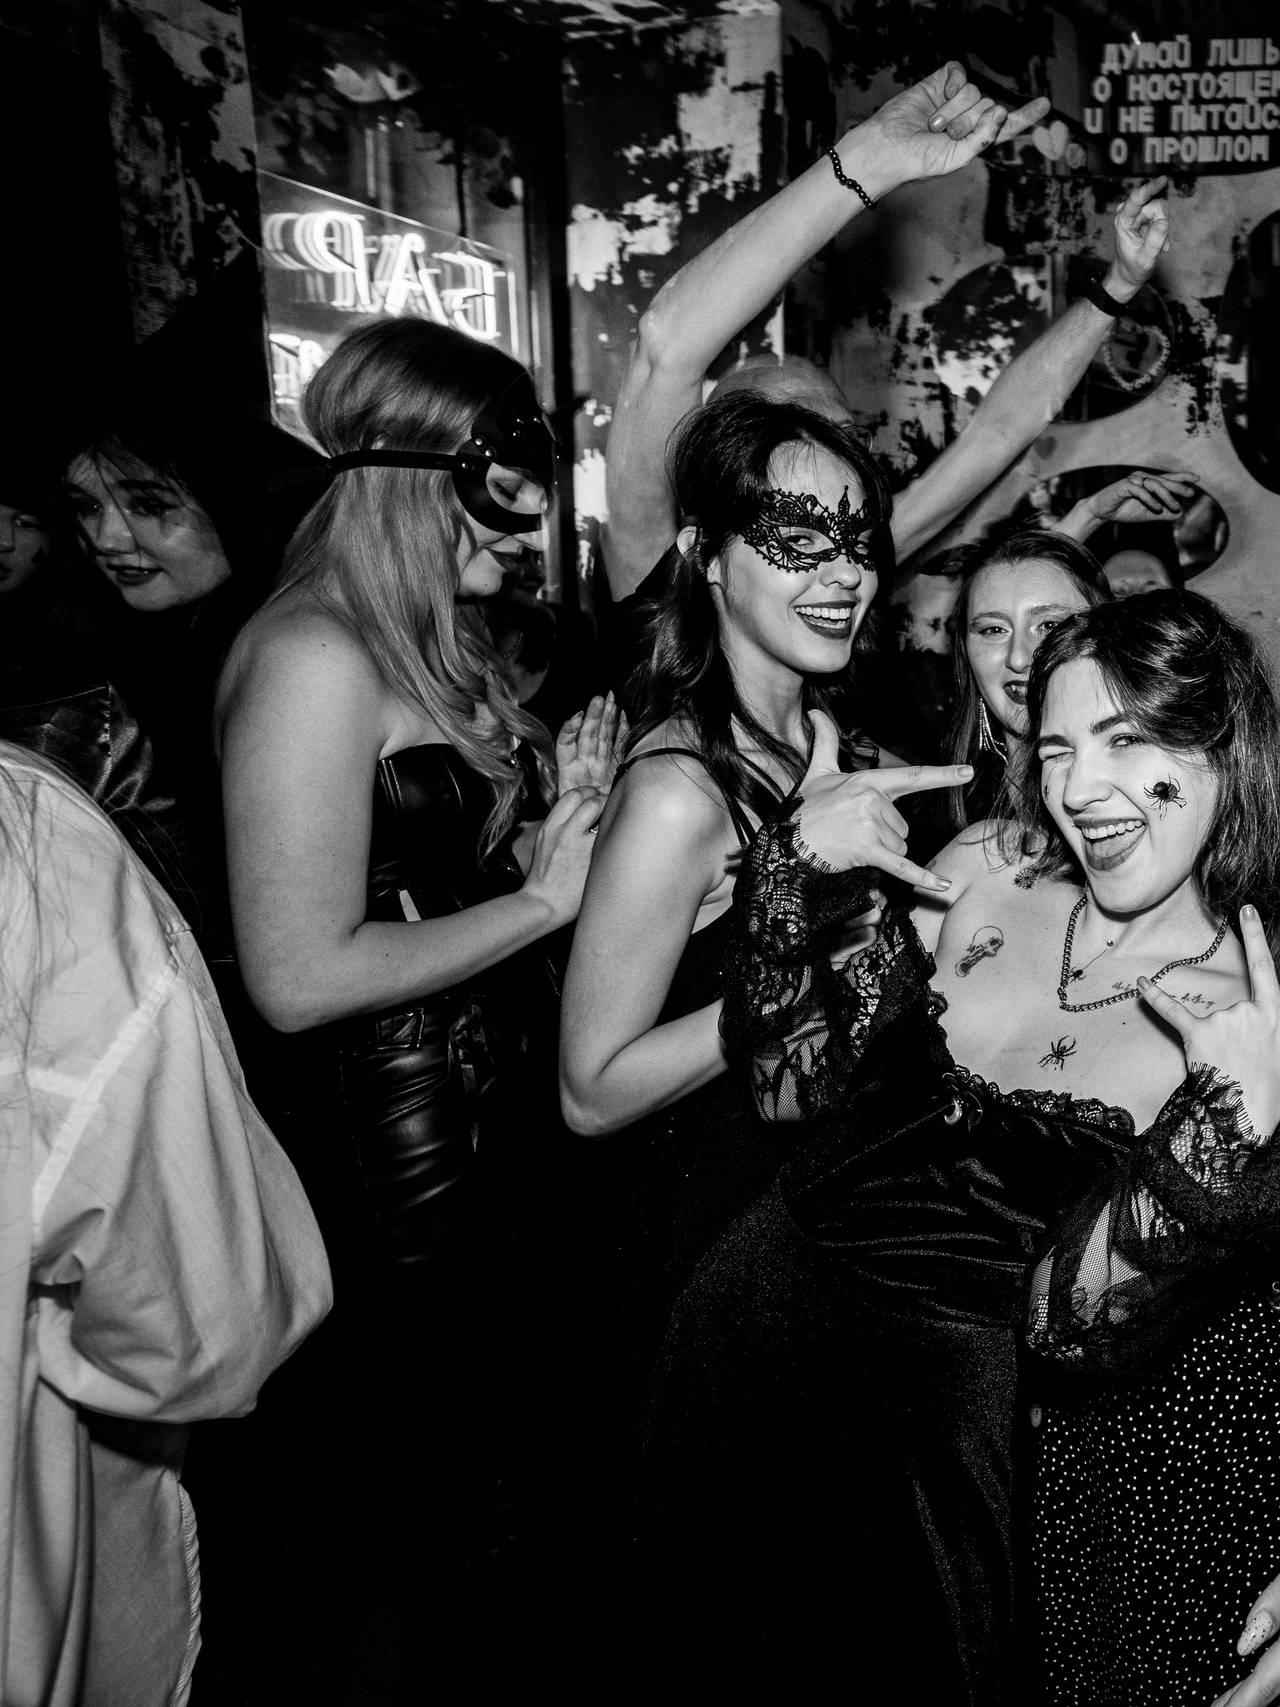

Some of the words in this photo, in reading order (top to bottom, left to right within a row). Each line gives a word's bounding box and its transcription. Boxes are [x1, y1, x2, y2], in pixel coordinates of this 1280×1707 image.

[1092, 75, 1113, 102] О
[1084, 106, 1104, 134] И
[1118, 104, 1156, 133] НЕ
[1109, 138, 1129, 165] О
[1145, 135, 1270, 163] ПРОШЛОМ
